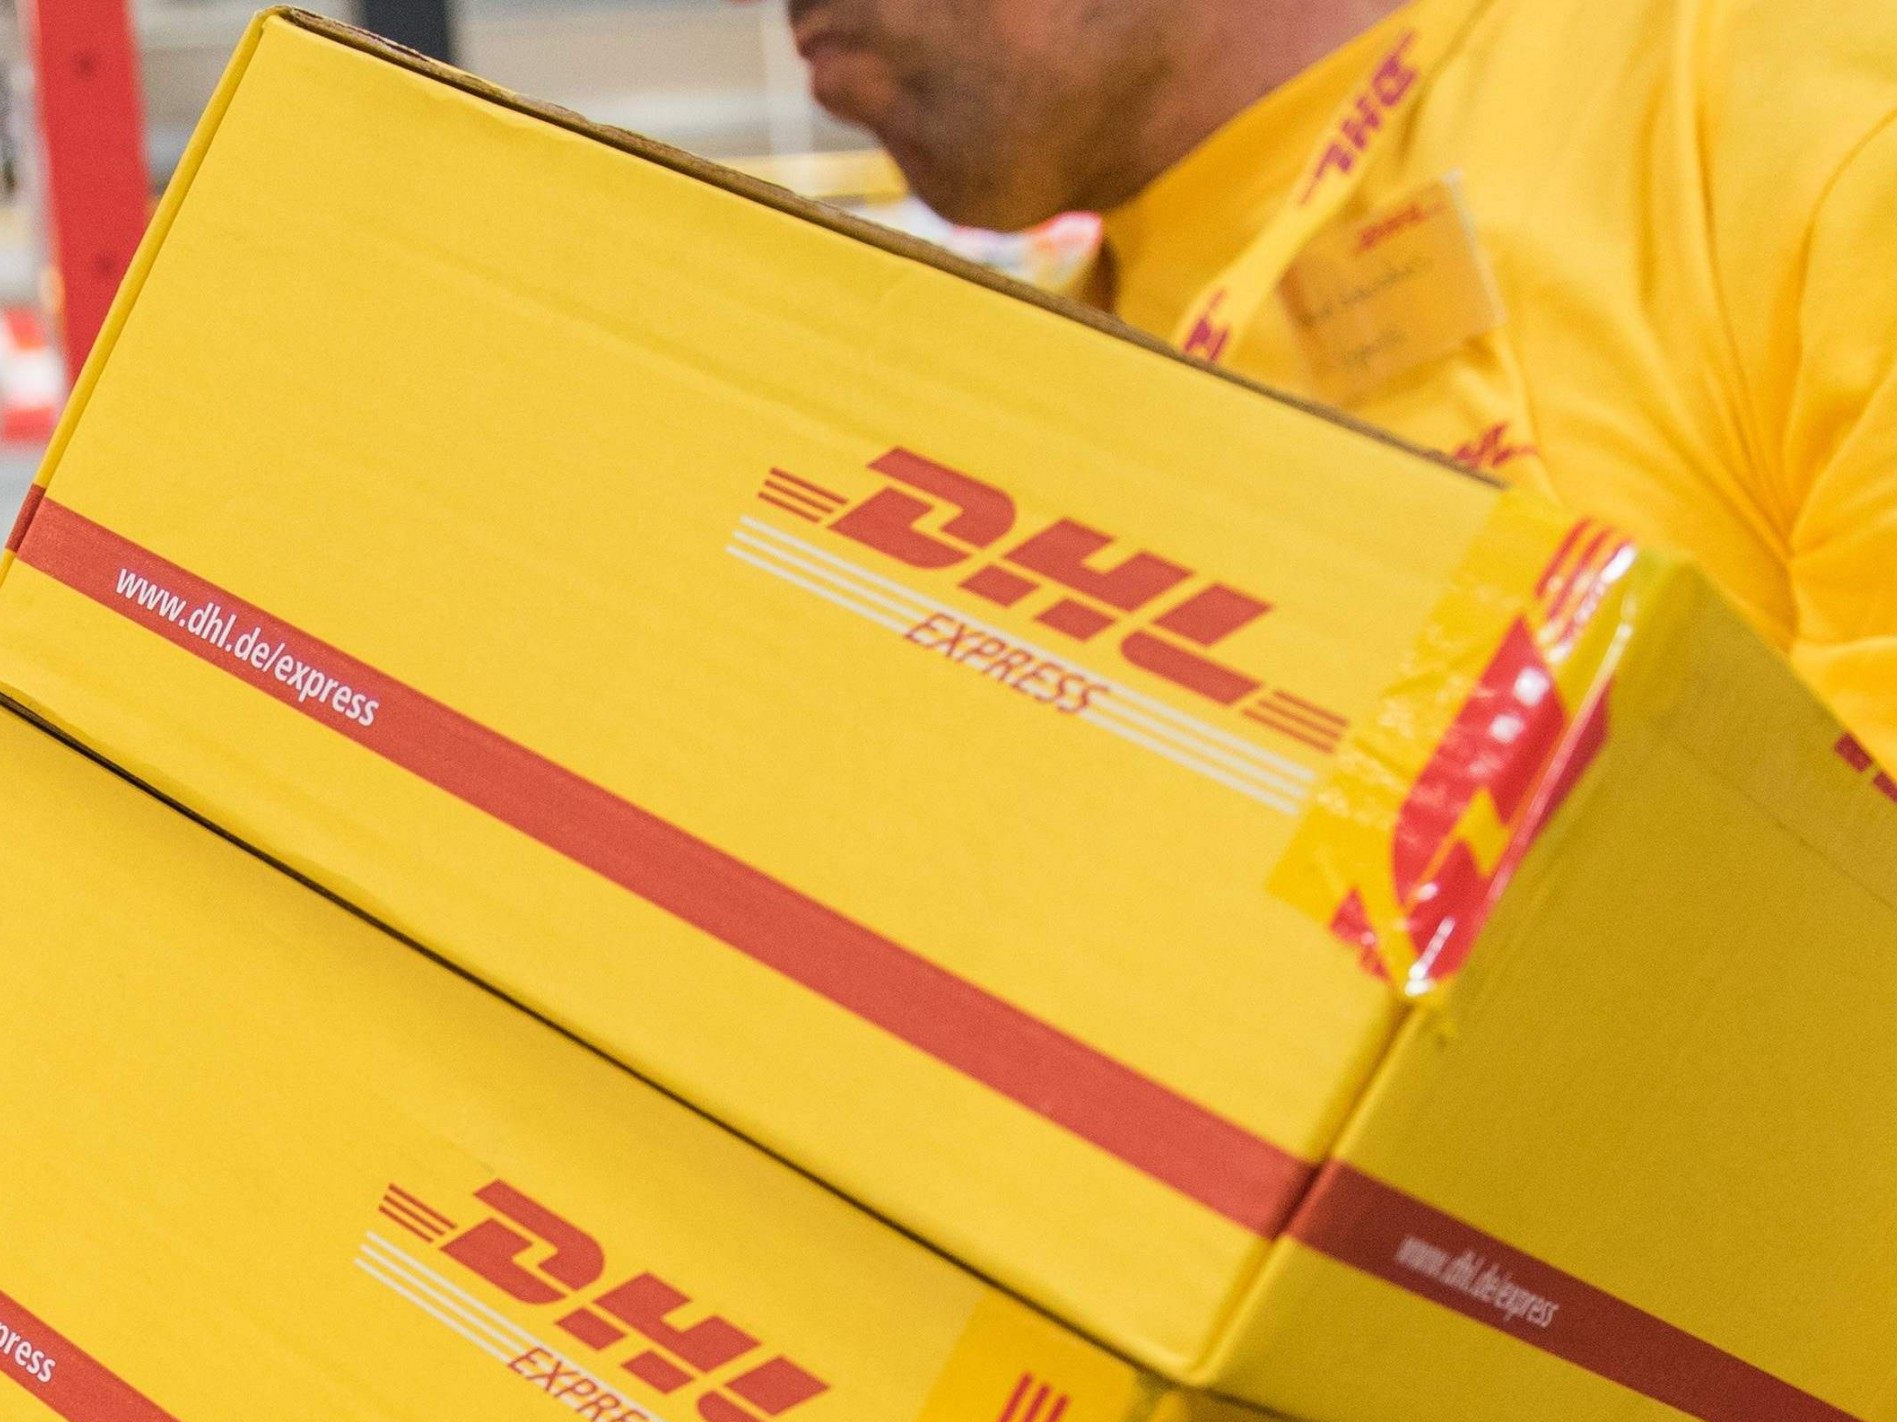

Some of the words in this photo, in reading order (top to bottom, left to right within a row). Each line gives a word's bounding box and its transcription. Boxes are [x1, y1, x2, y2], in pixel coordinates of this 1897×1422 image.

[115, 568, 380, 728] www.dhl.de/express
[826, 445, 1274, 707] DHL
[904, 612, 1108, 715] EXPRESS
